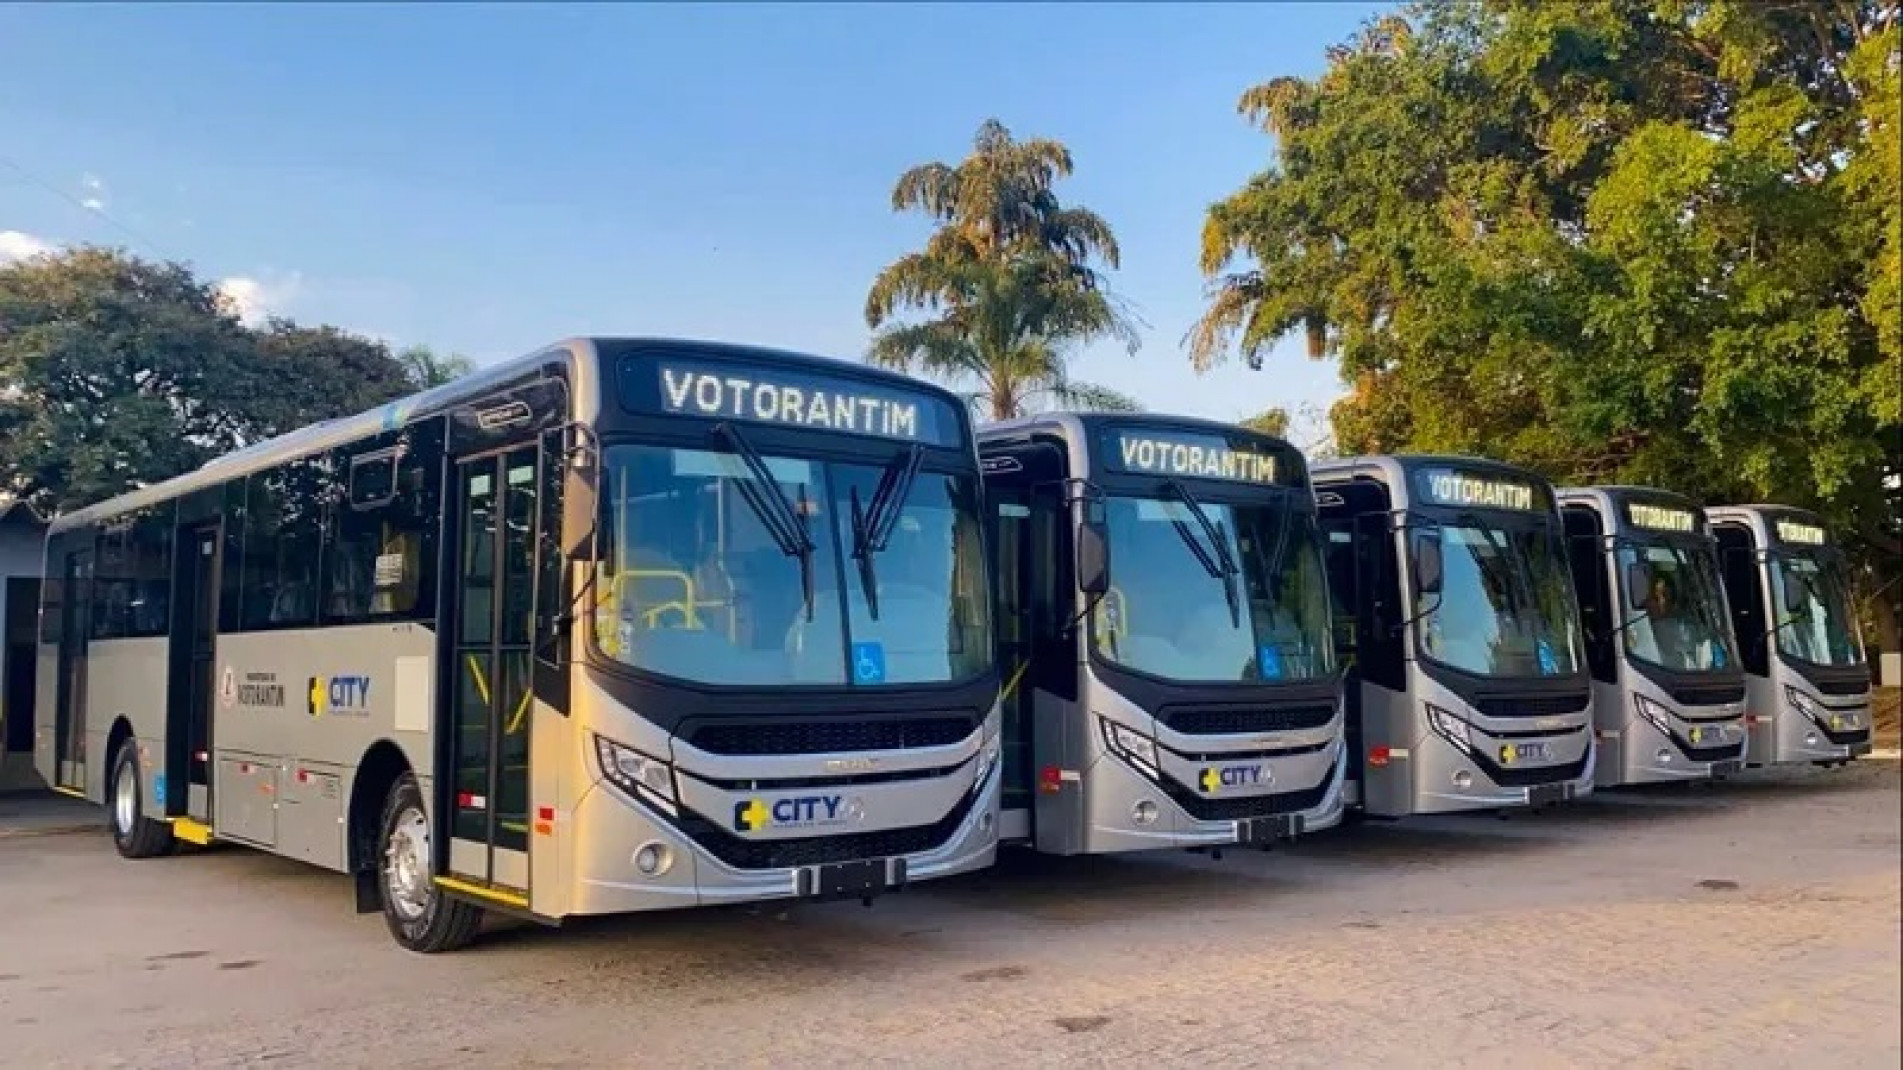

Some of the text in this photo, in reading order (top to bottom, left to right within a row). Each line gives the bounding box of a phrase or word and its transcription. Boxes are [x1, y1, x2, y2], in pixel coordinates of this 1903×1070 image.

[330, 675, 370, 708] CITY
[1221, 765, 1262, 786] CITY
[773, 796, 842, 822] CITY
